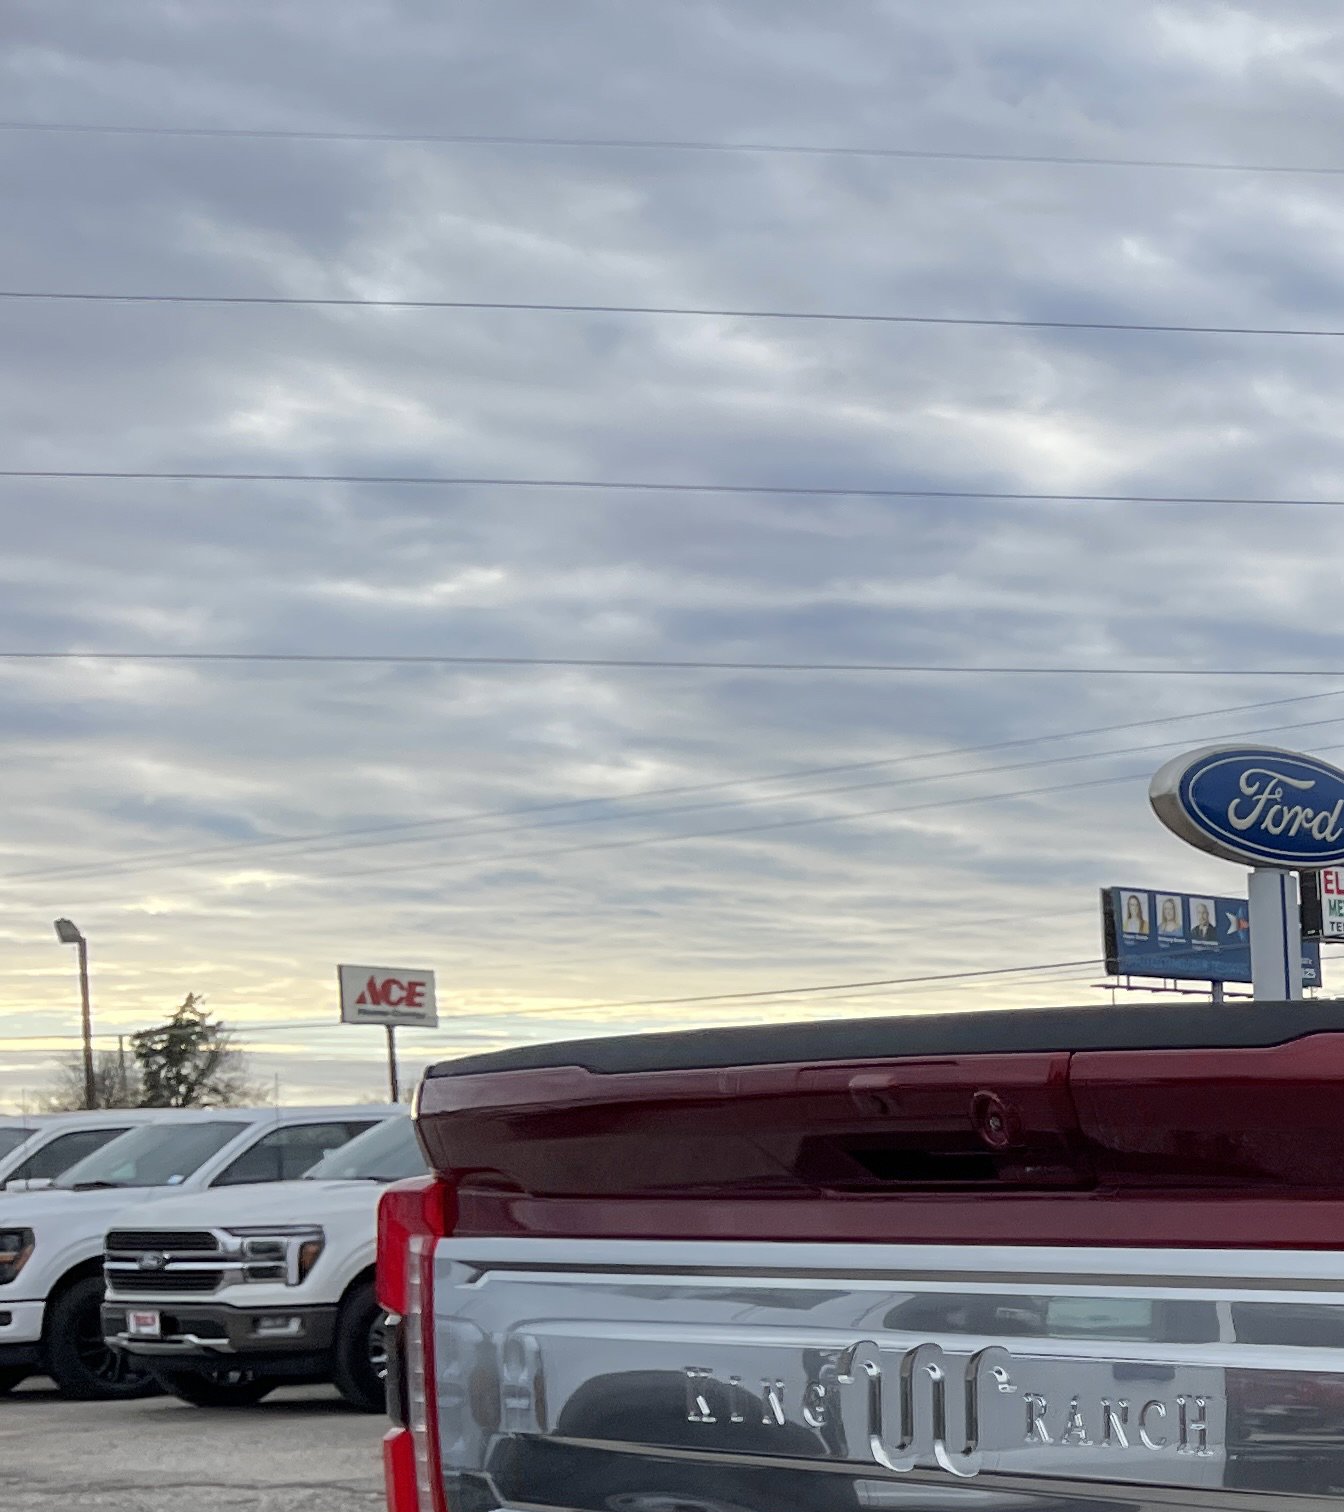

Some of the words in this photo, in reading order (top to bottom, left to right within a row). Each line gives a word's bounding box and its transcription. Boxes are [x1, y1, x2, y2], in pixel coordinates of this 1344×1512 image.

[1227, 767, 1344, 842] Ford
[355, 974, 426, 1007] ACE
[683, 1365, 828, 1428] KING
[1022, 1392, 1216, 1457] RANCH
